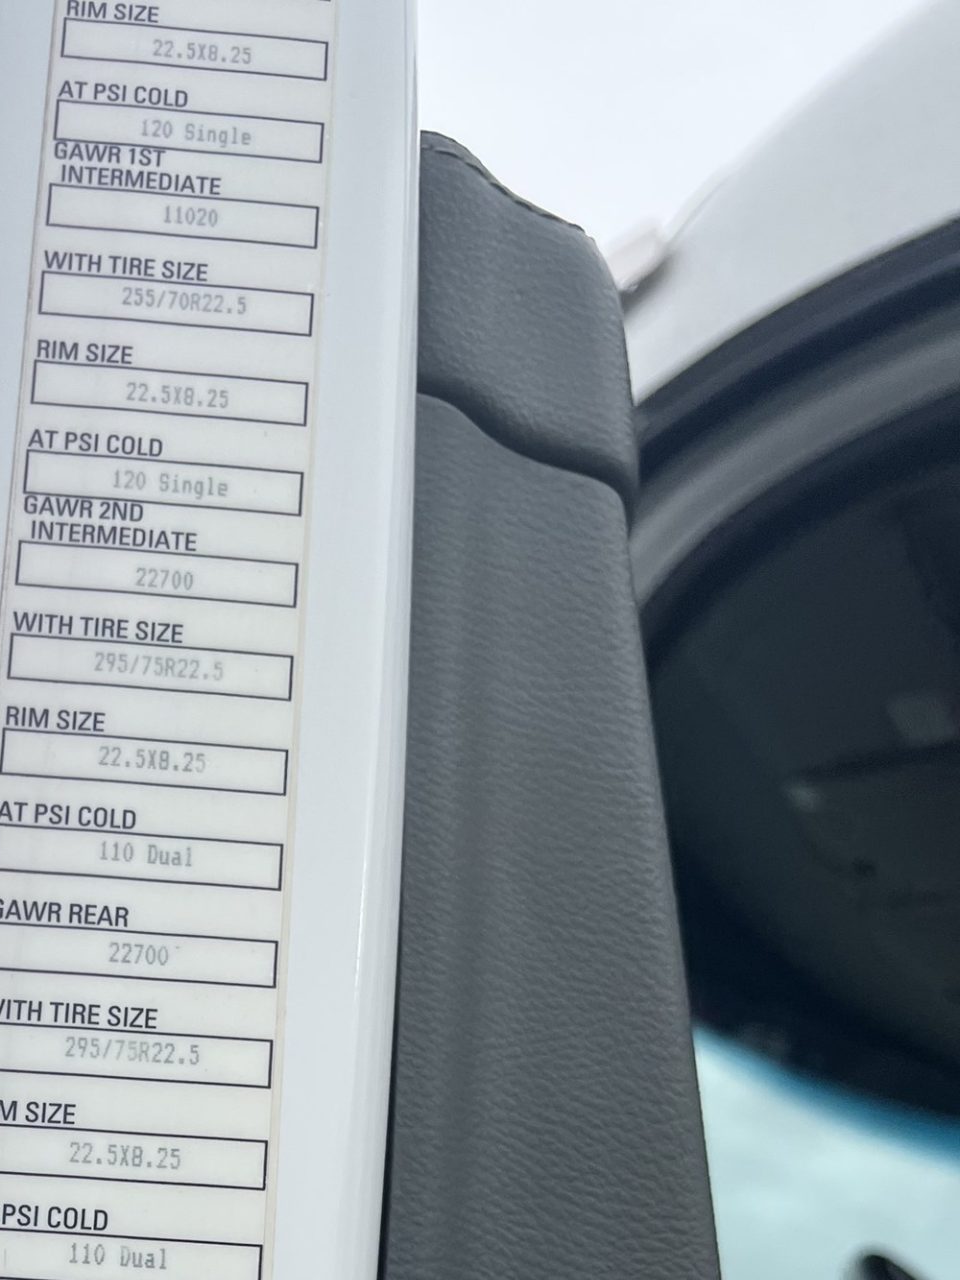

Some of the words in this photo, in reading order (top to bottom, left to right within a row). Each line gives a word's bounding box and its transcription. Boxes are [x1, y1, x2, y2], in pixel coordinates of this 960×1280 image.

[66, 0, 107, 19] RIM
[113, 3, 159, 23] SIZE
[152, 39, 252, 65] 22.5X8.25
[58, 80, 88, 99] AT
[93, 83, 127, 102] PSI
[134, 86, 188, 108] COLD
[140, 119, 173, 139] 120
[184, 123, 252, 147] Single
[54, 141, 121, 164] GAWR
[129, 146, 166, 167] 1ST
[60, 164, 222, 195] INTERMEDIATE
[163, 205, 218, 227] 11020
[44, 250, 102, 273] WITH
[108, 255, 156, 278] TIRE
[161, 260, 209, 282] SIZE
[121, 287, 247, 315] 255/70R22.5
[36, 339, 79, 361] RIM
[85, 343, 133, 365] SIZE
[126, 382, 229, 409] 22.5X8.25
[28, 428, 59, 448] AT
[64, 431, 99, 452] PSI
[106, 434, 164, 457] COLD
[113, 469, 146, 491] 120
[159, 473, 229, 499] Single
[23, 495, 93, 519] GAWR
[99, 501, 144, 522] 2ND
[31, 520, 198, 552] INTERMEDIATE
[135, 567, 194, 590] 22700
[12, 611, 73, 635] WITH
[79, 617, 129, 639] TIRE
[134, 621, 184, 644] SIZE
[93, 652, 224, 681] 295/75R22.5
[5, 706, 49, 729] RIM
[56, 710, 106, 732] SIZE
[97, 746, 207, 773] 22.5X8.25
[34, 803, 70, 825] PSI
[77, 806, 137, 830] COLD
[99, 841, 134, 862] 110
[147, 844, 193, 867] Dual
[68, 903, 129, 927] REAR
[108, 942, 169, 966] 22700
[49, 1001, 101, 1025] TIRE
[107, 1005, 158, 1029] SIZE
[64, 1036, 200, 1066] 295/75R22.5
[24, 1101, 76, 1125] SIZE
[69, 1142, 181, 1170] 22.5X8.25
[1, 1203, 39, 1227] PSI
[47, 1206, 108, 1231] COLD
[68, 1243, 106, 1265] 110
[120, 1245, 167, 1270] Dual
